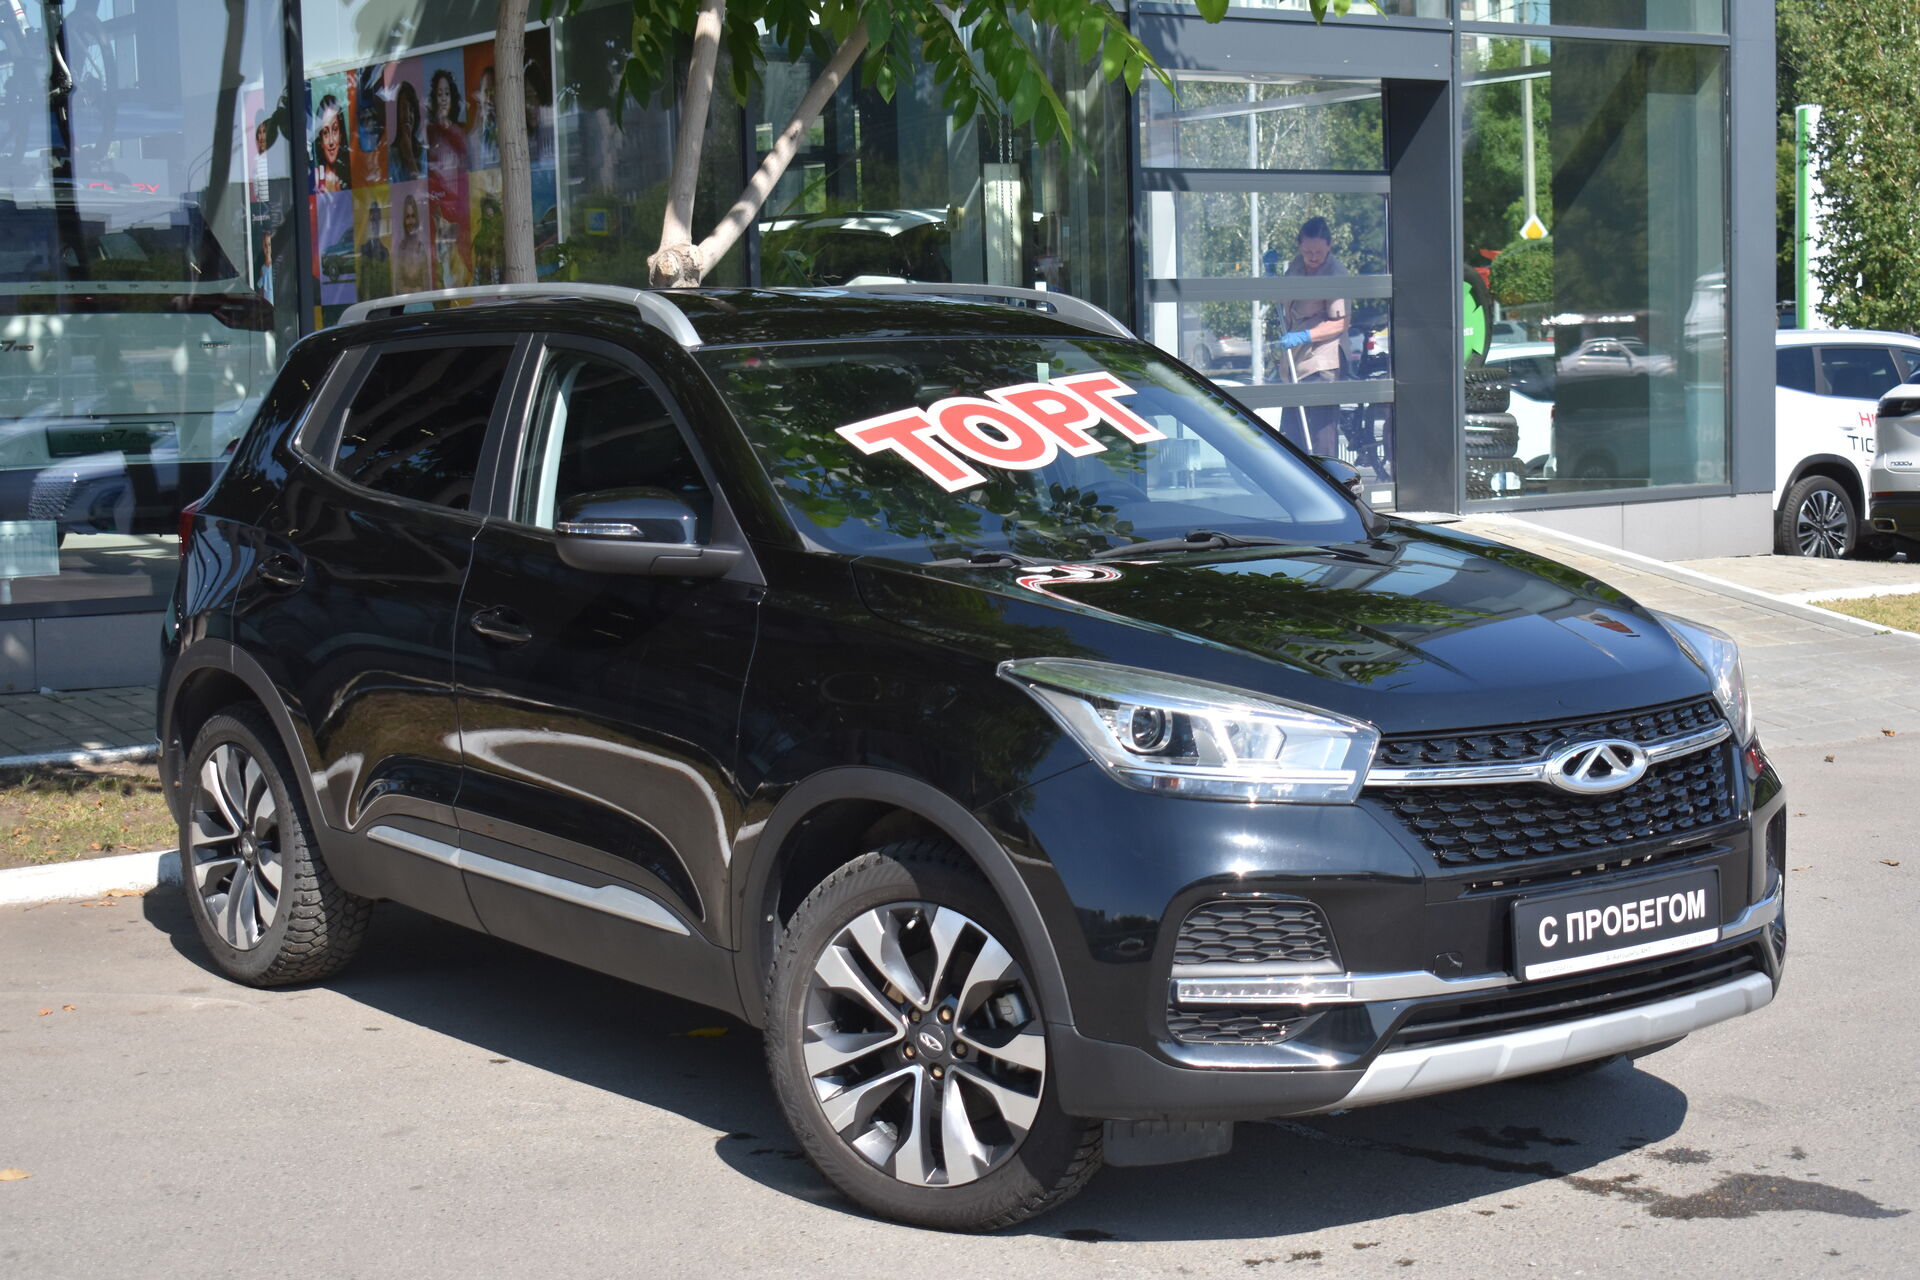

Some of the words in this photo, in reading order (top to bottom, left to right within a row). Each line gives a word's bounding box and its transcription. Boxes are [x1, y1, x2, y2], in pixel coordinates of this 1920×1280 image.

[836, 372, 1166, 492] ТОРГ
[1538, 916, 1558, 948] С
[1566, 888, 1706, 944] ПРОБЕГОМ
